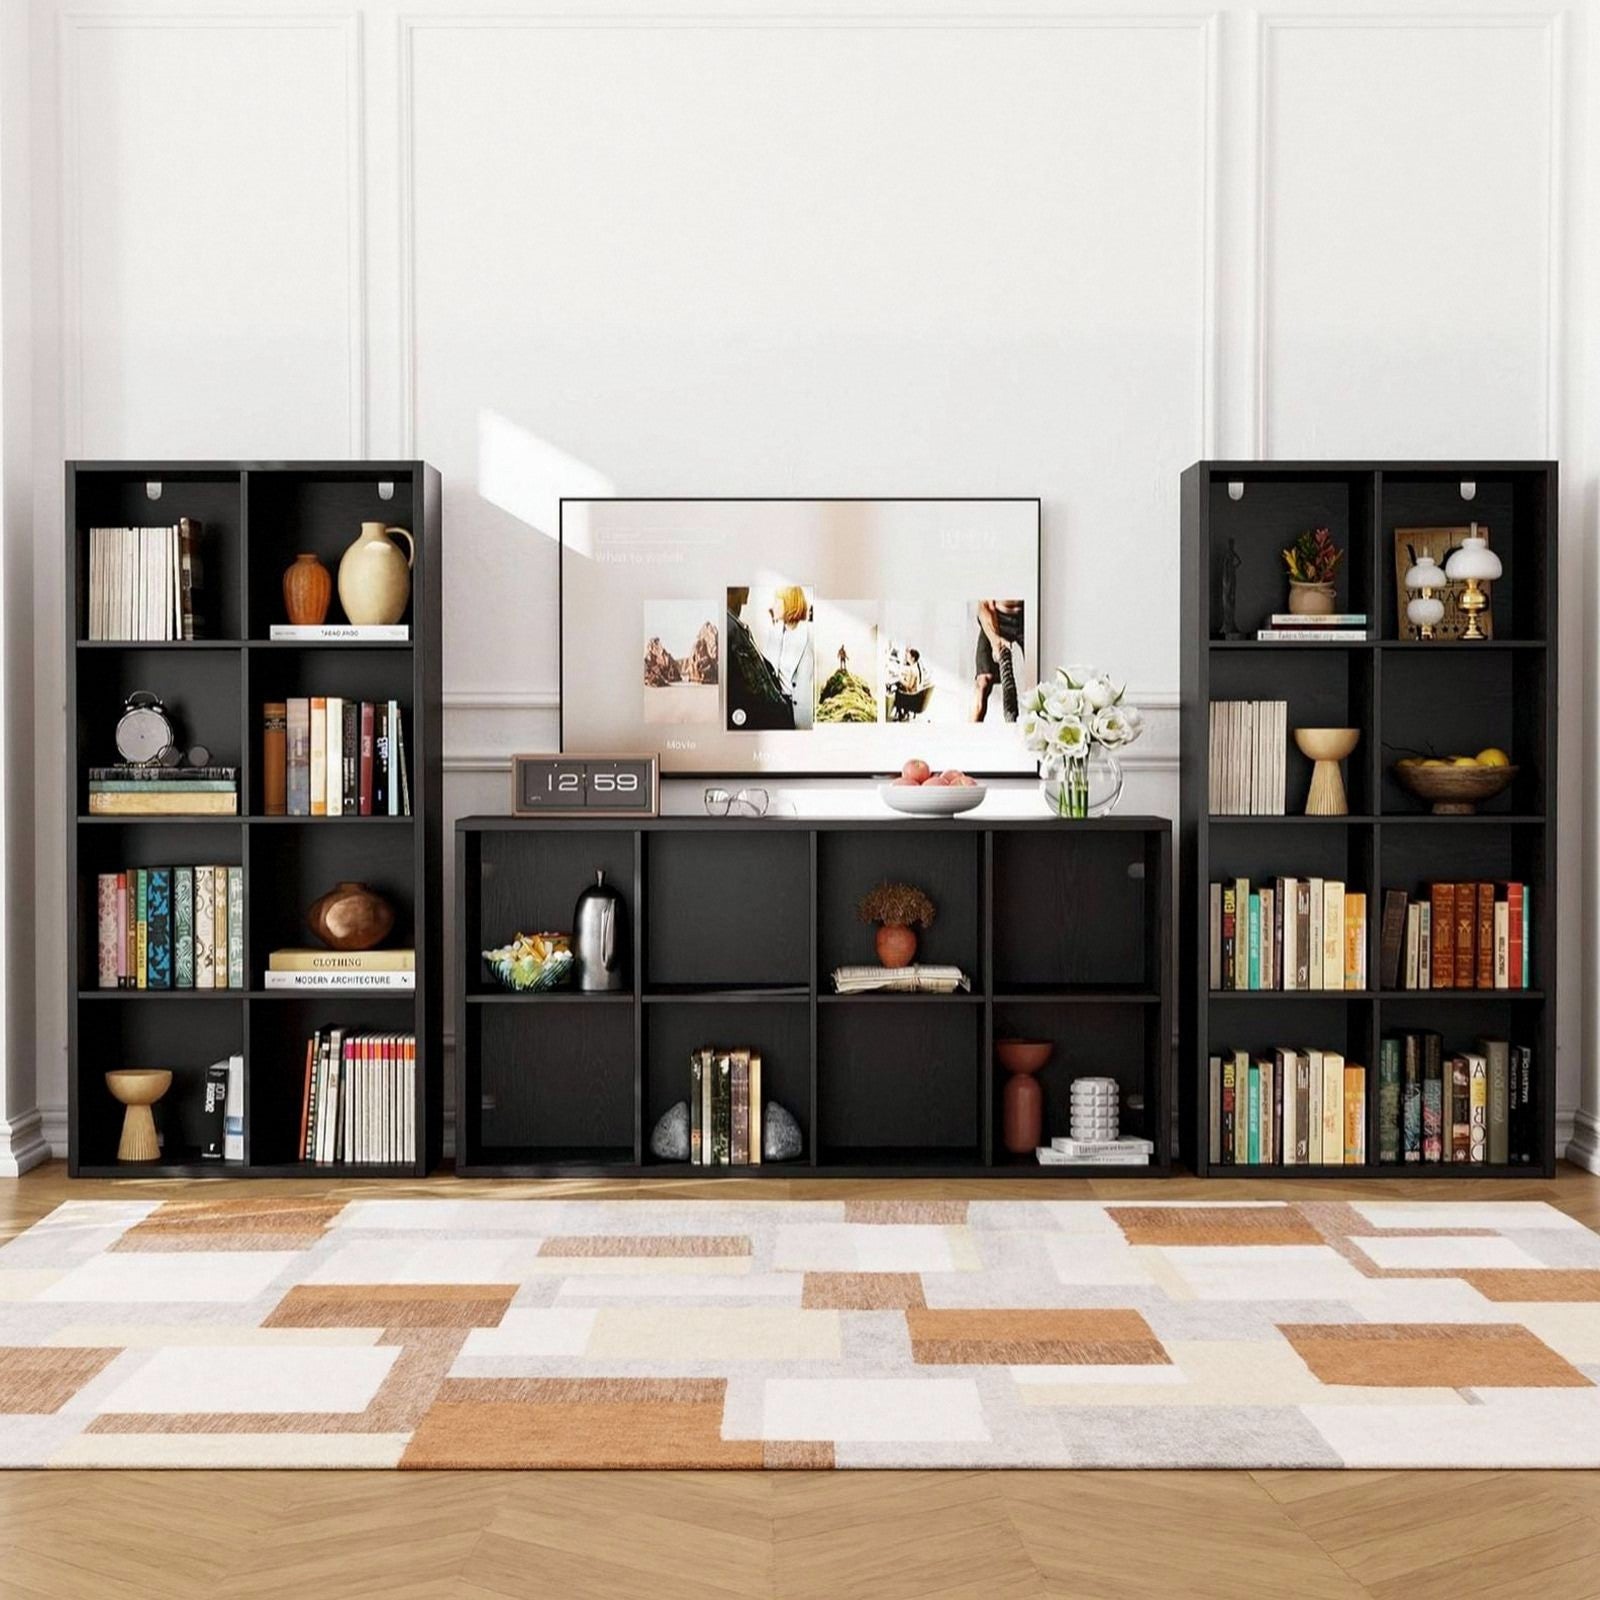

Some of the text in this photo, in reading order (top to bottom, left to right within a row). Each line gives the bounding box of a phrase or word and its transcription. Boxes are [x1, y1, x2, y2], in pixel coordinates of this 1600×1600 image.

[666, 740, 697, 750] Movie
[313, 959, 361, 967] CLOTHING
[295, 976, 328, 985] MODERN
[331, 976, 391, 985] ARCHITECTURE
